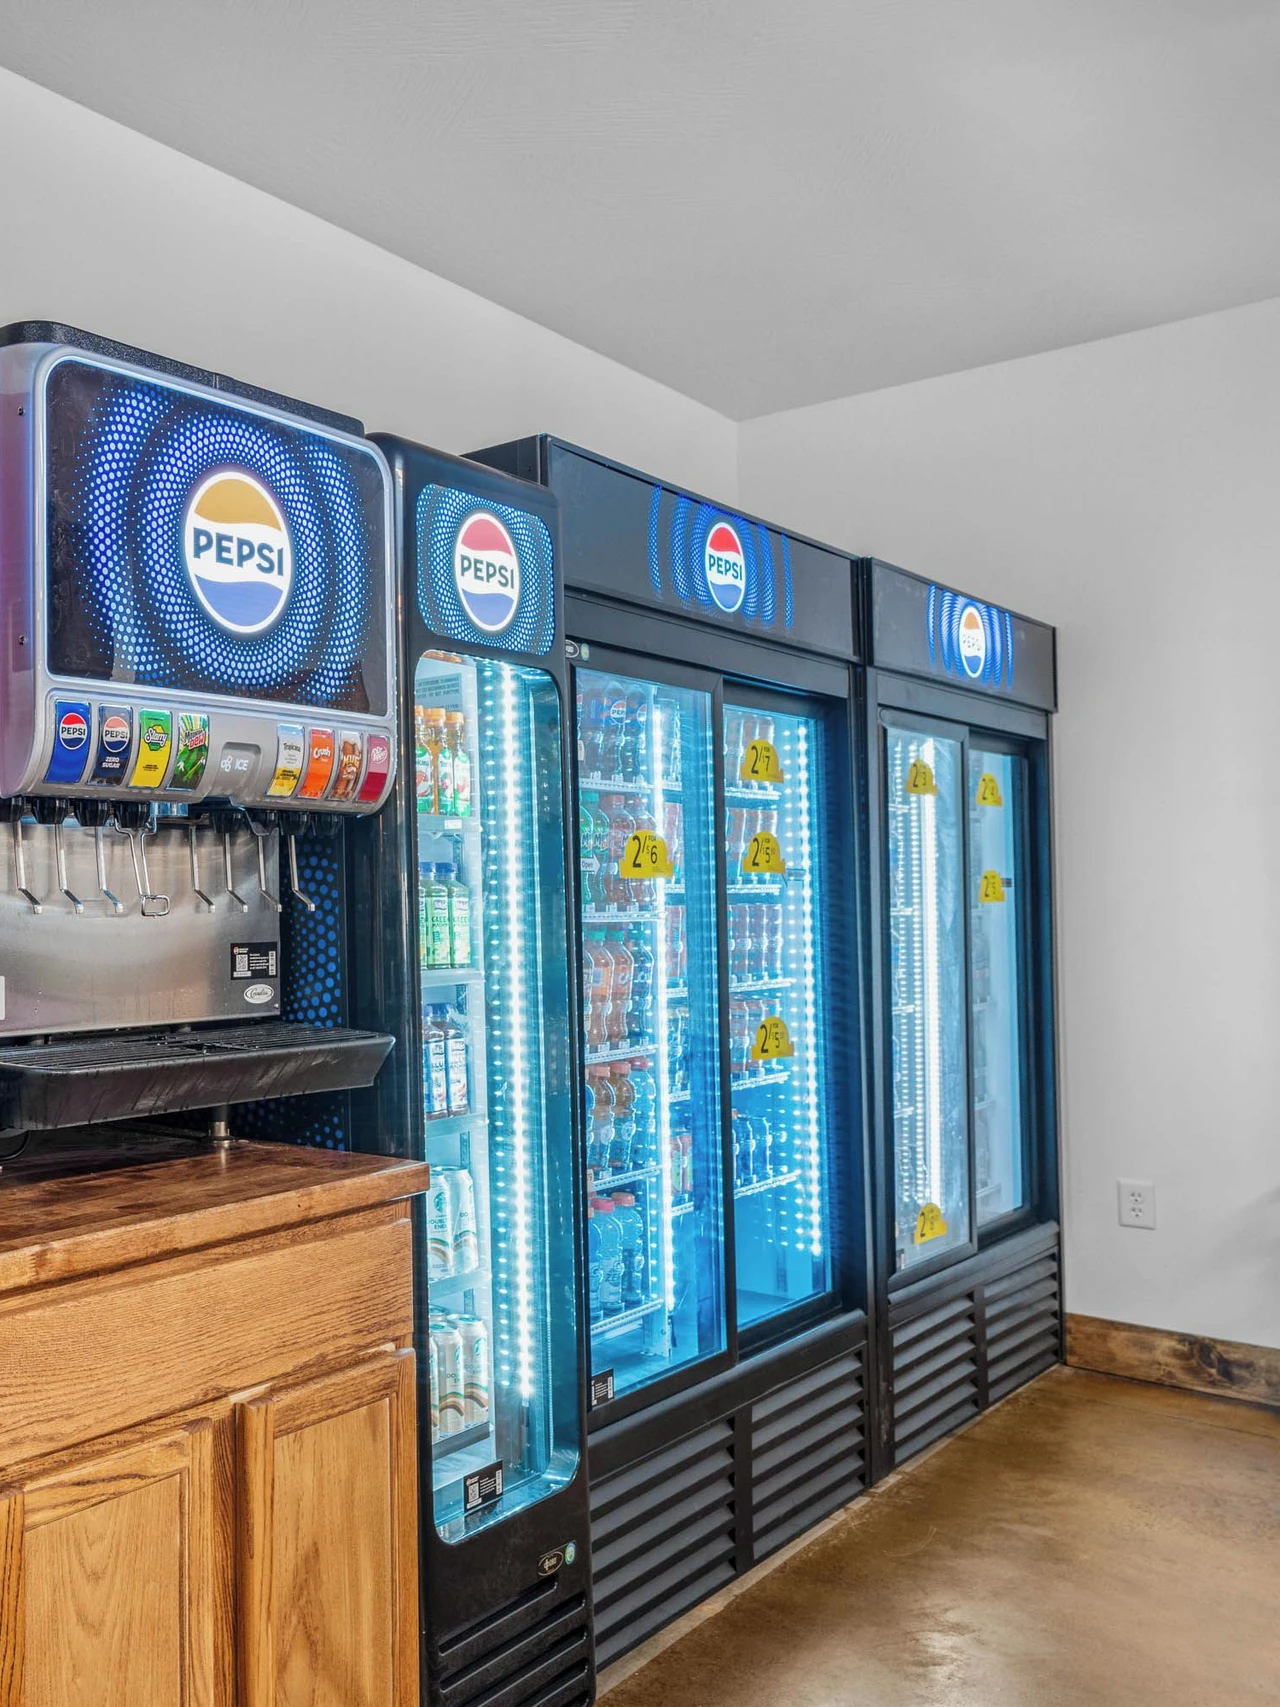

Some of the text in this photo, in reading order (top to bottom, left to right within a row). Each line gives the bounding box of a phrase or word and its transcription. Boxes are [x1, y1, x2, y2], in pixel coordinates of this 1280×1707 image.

[193, 528, 284, 577] PEPSI
[460, 554, 515, 589] PEPSI
[708, 553, 743, 581] PEPSI
[60, 727, 86, 736] PEPSI
[104, 729, 129, 739] PEPSI
[235, 759, 249, 771] ICE
[343, 754, 360, 767] MUG
